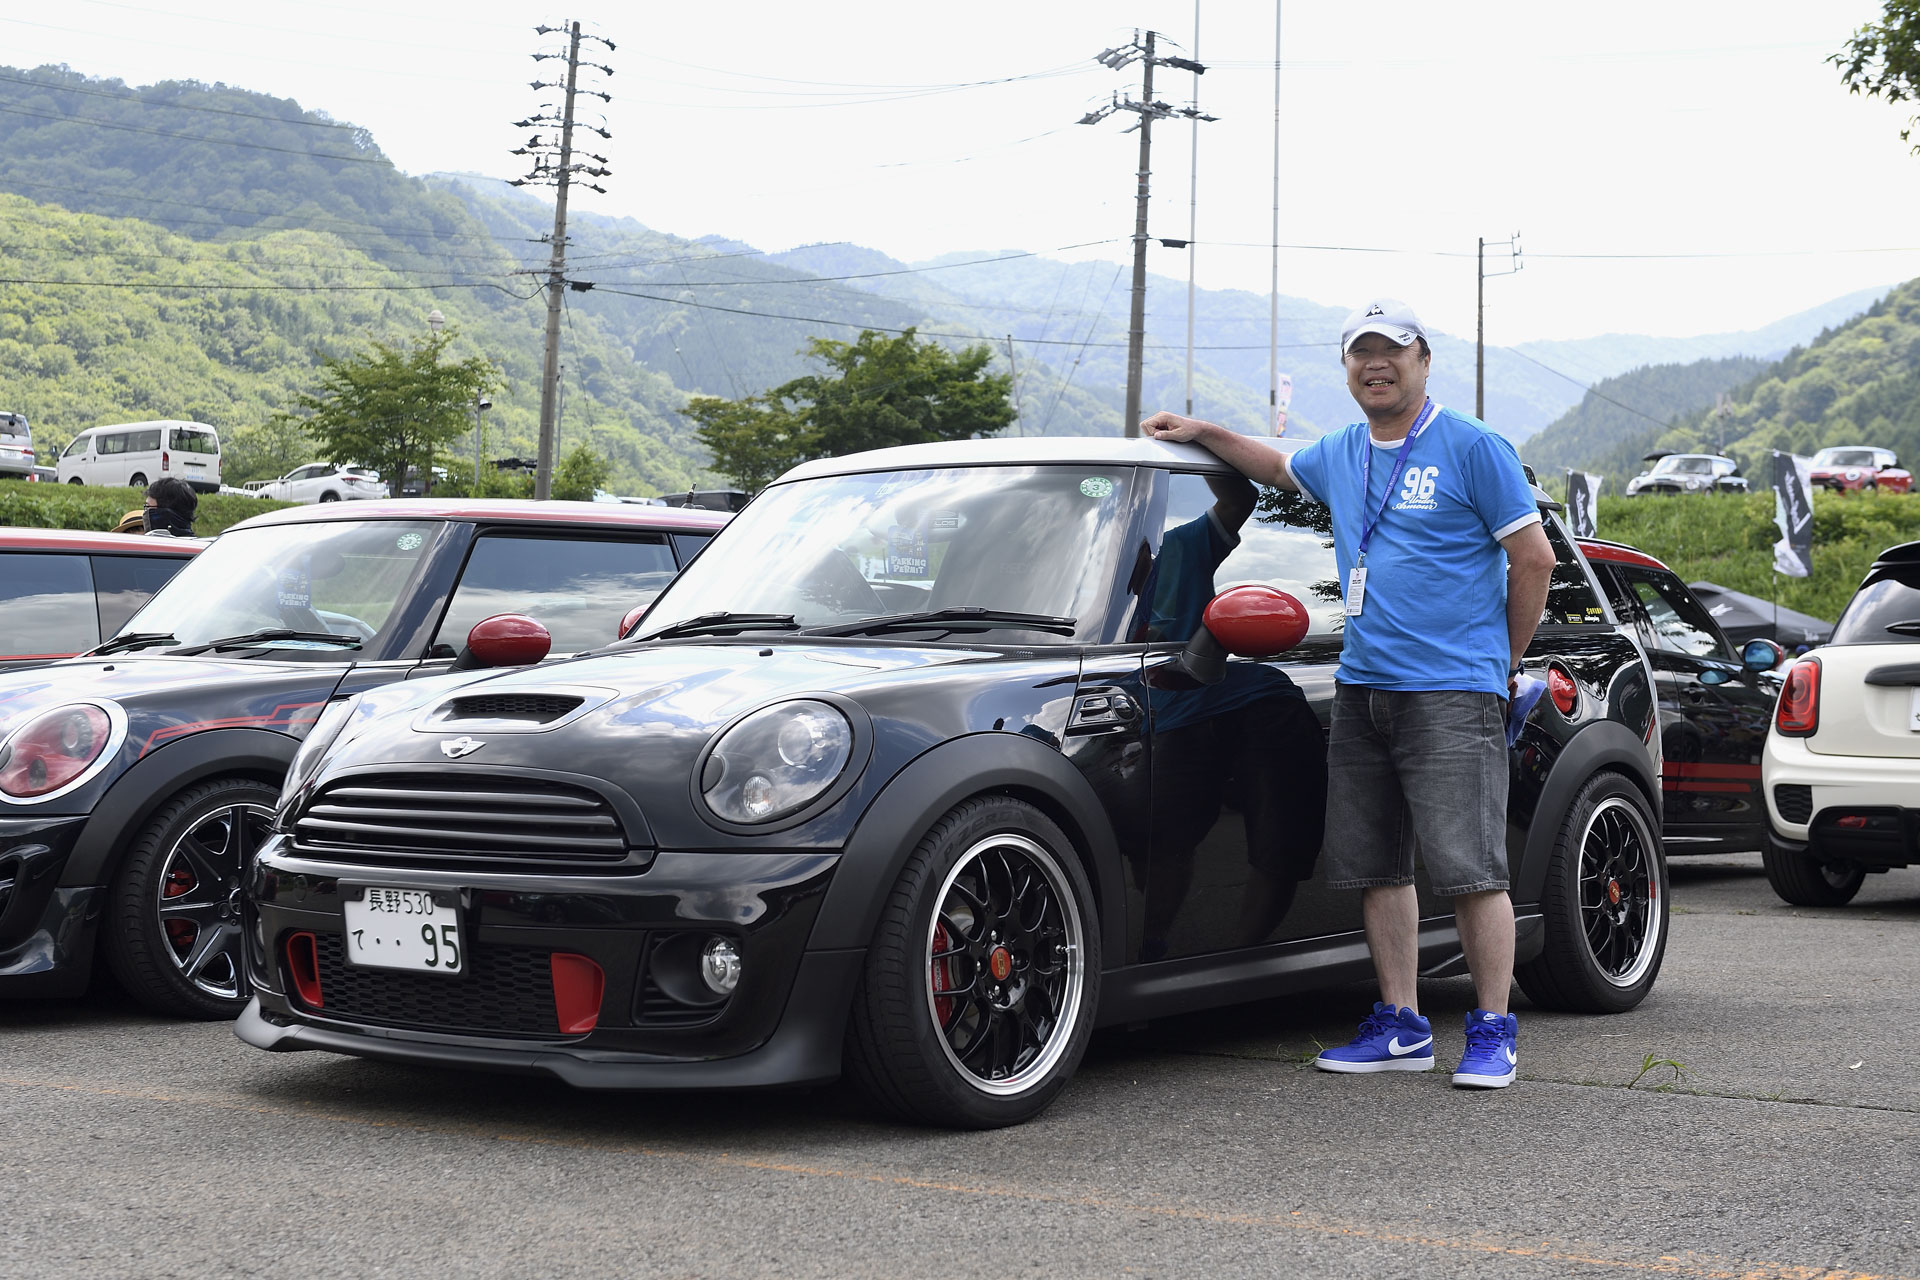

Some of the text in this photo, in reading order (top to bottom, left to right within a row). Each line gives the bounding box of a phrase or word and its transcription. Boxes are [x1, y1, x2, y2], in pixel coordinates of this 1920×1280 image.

[1401, 466, 1439, 500] 96
[890, 555, 927, 567] PARKING
[893, 564, 925, 574] PERMIT
[369, 889, 434, 915] 長野530
[421, 923, 460, 969] 95
